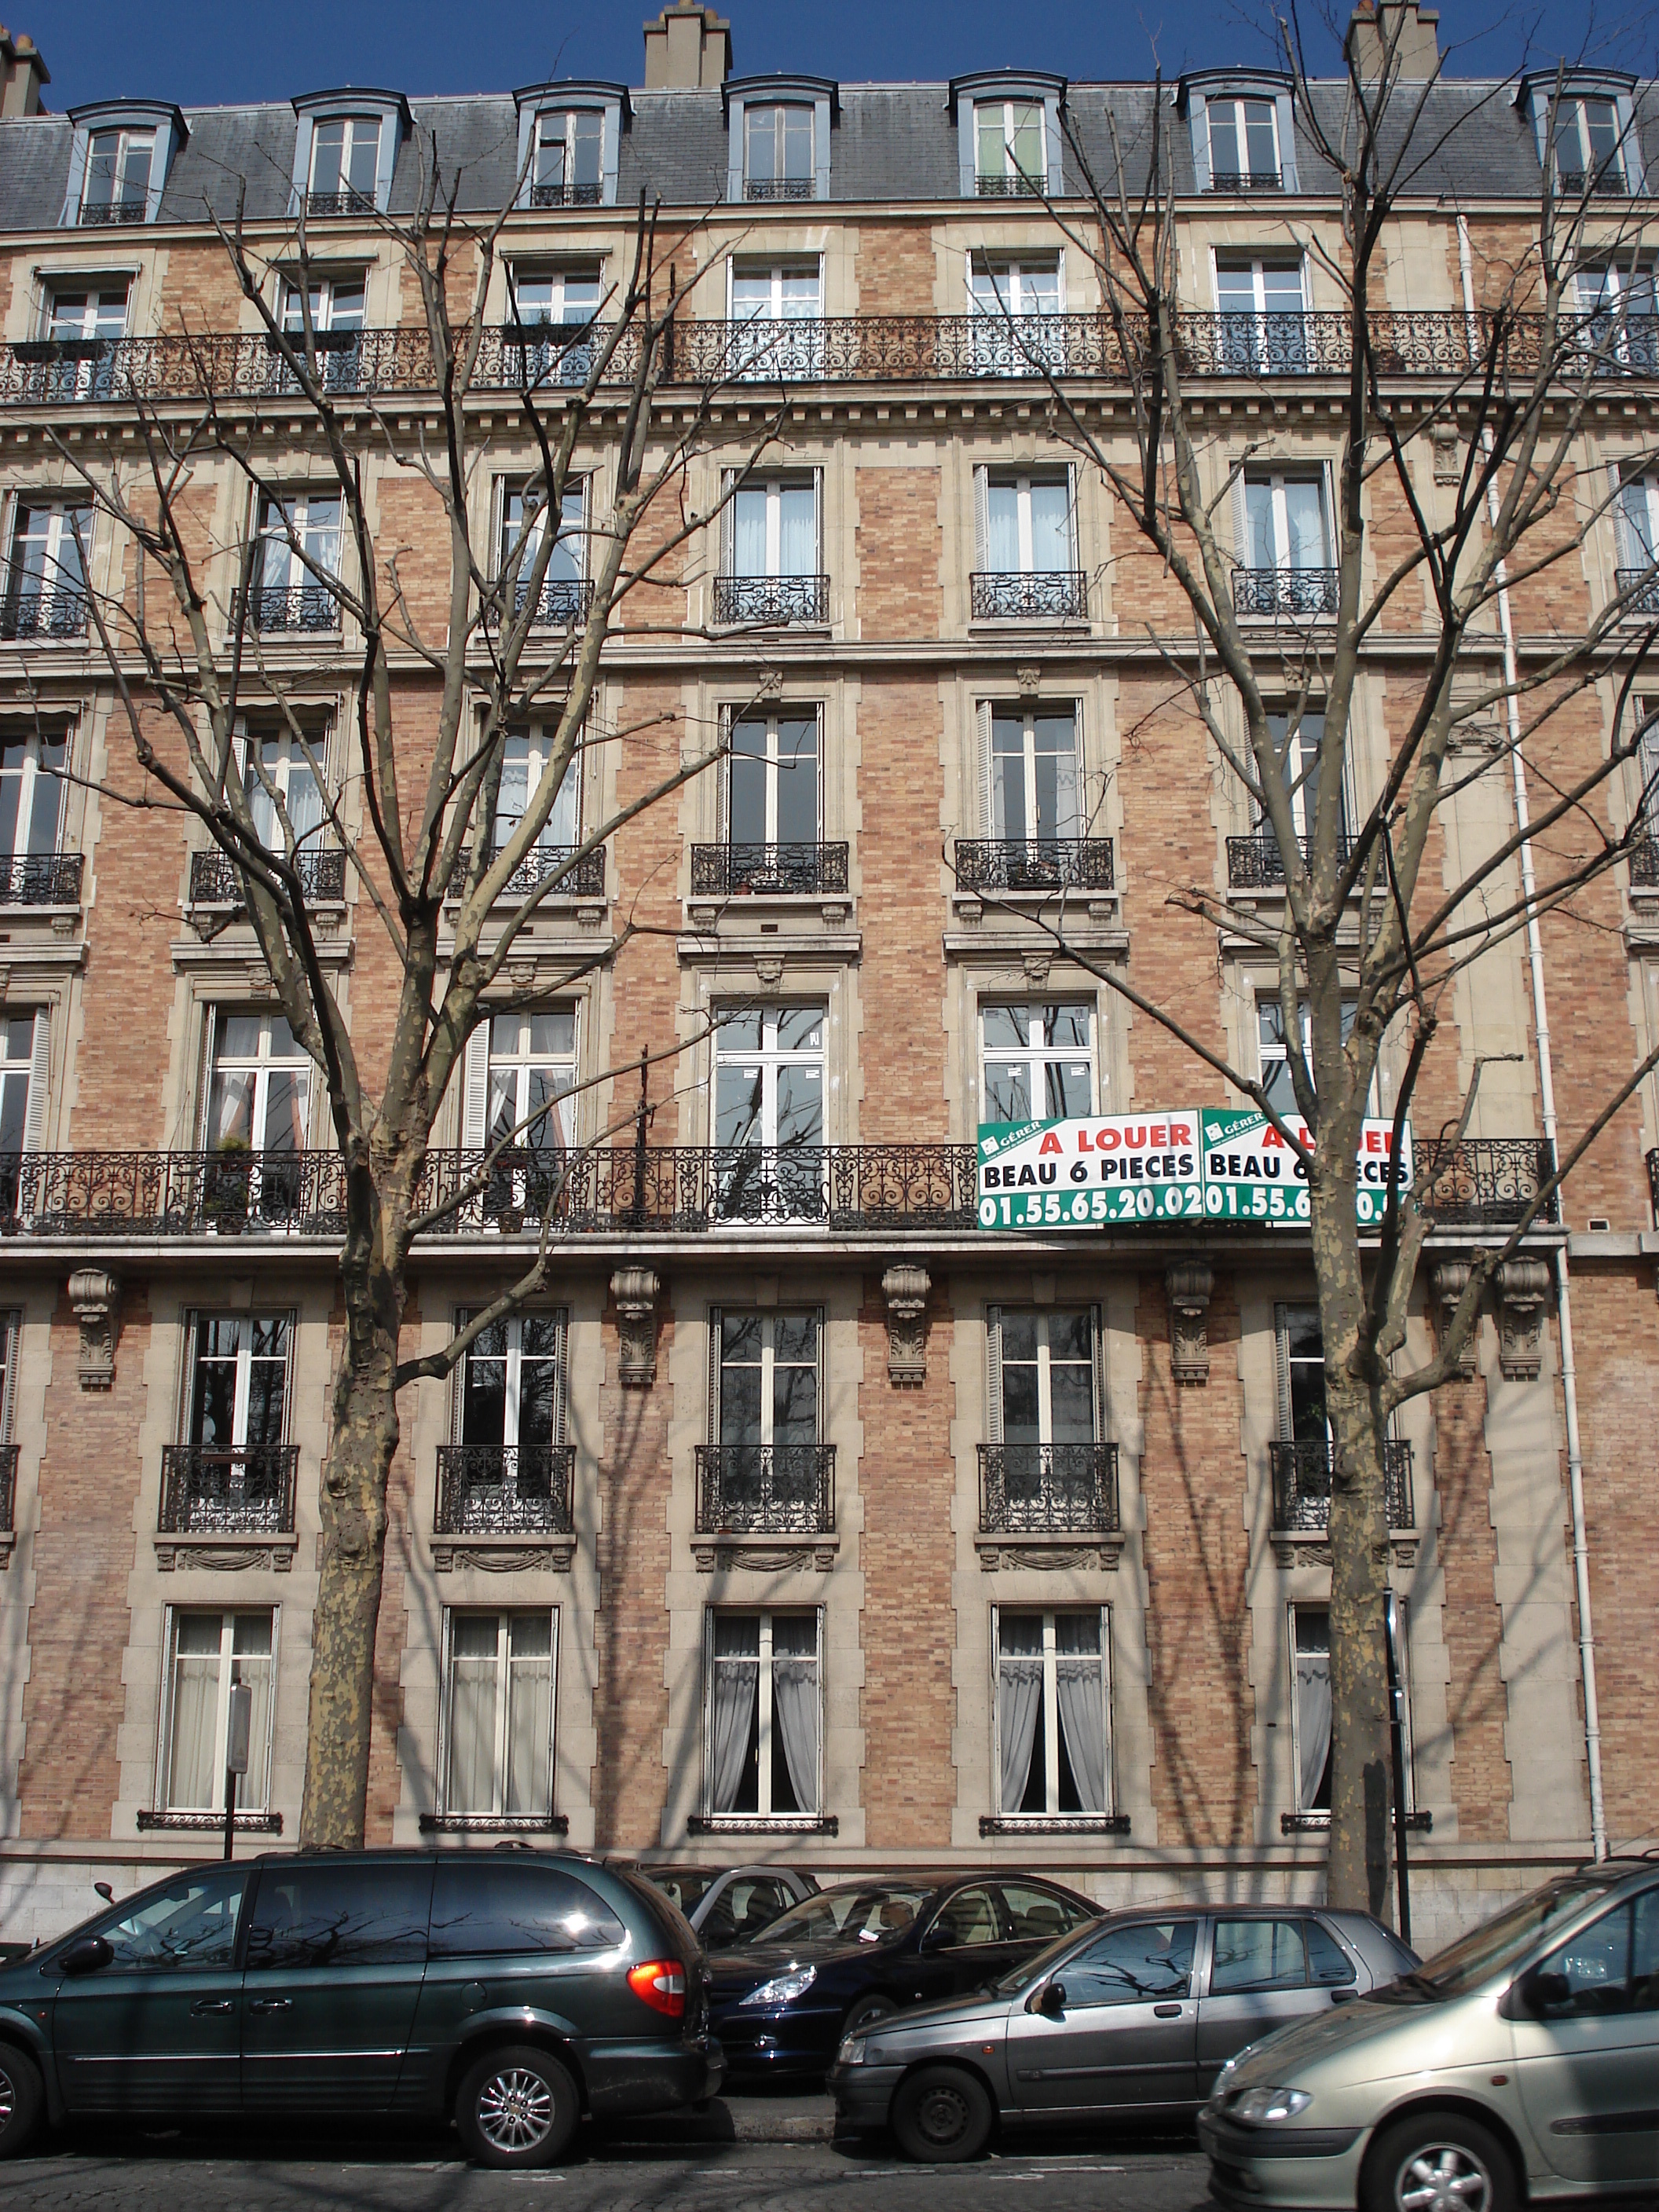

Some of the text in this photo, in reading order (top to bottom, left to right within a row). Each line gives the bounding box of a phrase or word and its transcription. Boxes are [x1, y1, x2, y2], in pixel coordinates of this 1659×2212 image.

[1000, 1121, 1042, 1147] GÉRER
[1224, 1111, 1265, 1135] GÉRER
[1038, 1132, 1064, 1155] A
[1078, 1123, 1193, 1153] LOUER
[1261, 1126, 1286, 1148] A
[984, 1153, 1194, 1188] BEAU 6 PIECES
[1210, 1153, 1280, 1178] BEAU
[979, 1185, 1203, 1226] 01.55.65.20.02
